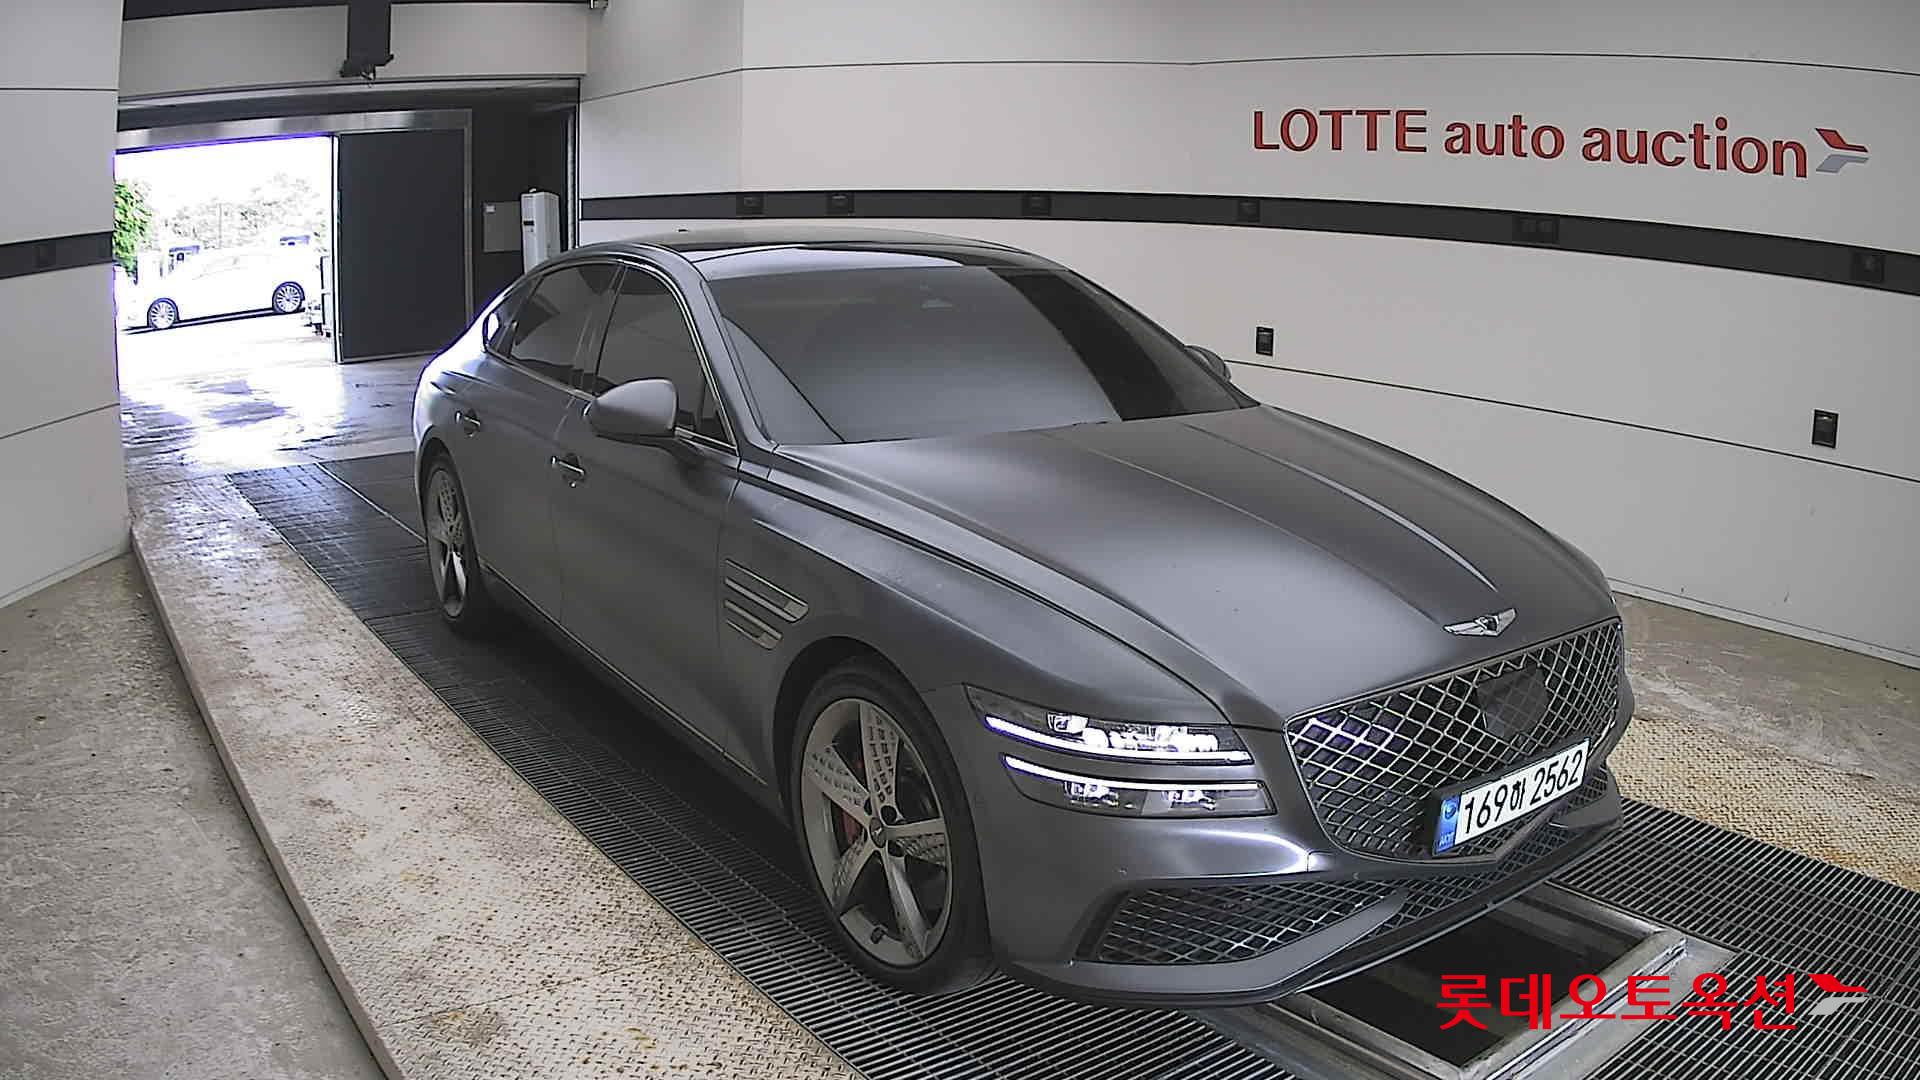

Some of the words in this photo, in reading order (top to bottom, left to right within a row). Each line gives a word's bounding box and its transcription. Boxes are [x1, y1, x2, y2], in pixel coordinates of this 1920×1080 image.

[1253, 109, 1428, 152] LOTTE
[1443, 114, 1566, 160] auto
[1581, 116, 1809, 179] auction
[1465, 777, 1527, 835] 169하
[1529, 749, 1583, 806] 2562
